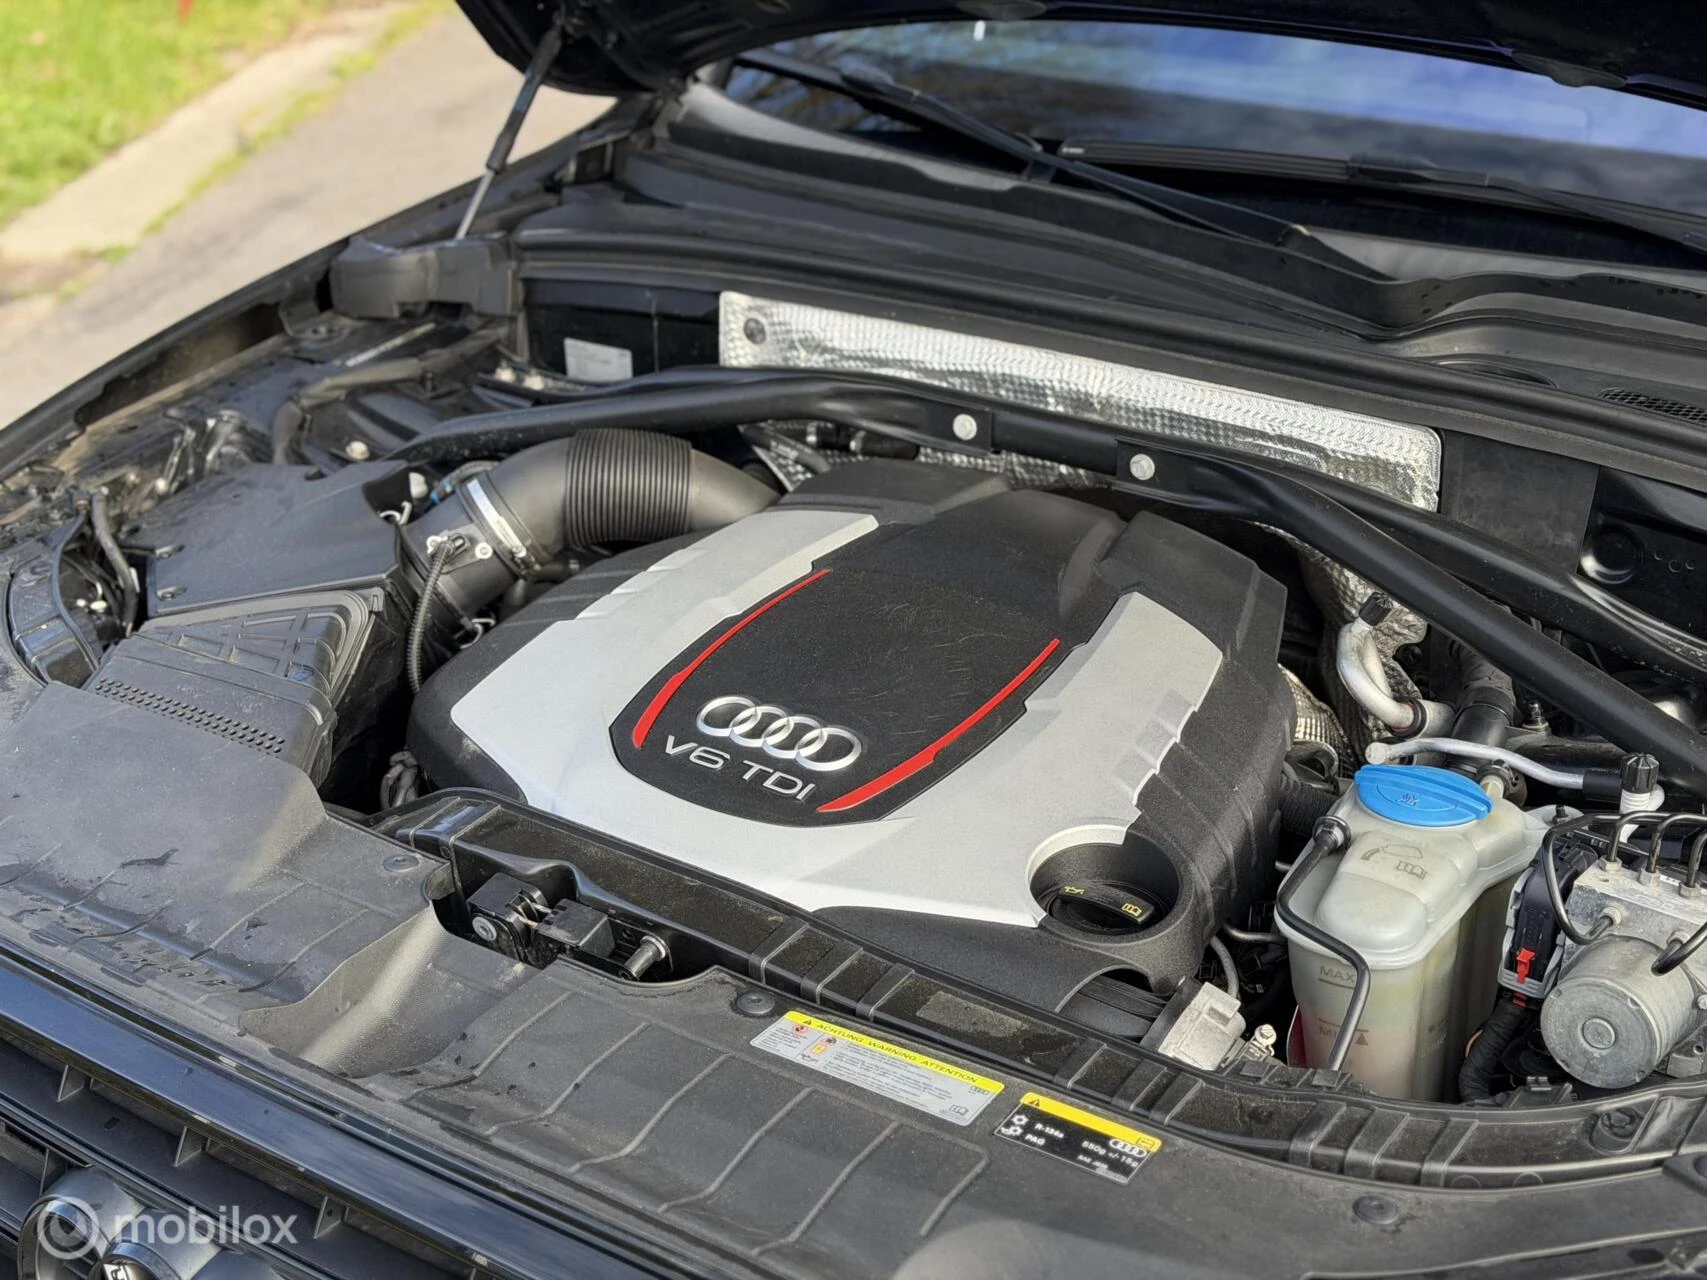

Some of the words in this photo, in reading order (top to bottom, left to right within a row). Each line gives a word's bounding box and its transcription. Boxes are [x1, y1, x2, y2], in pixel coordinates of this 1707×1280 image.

[665, 735, 731, 769] V6
[742, 760, 816, 800] TDI
[1320, 966, 1354, 983] MAX
[816, 1024, 864, 1043] ACHTUNG
[868, 1040, 918, 1062] WARNING
[921, 1060, 978, 1084] ATTENTION
[1025, 1133, 1046, 1146] PAG
